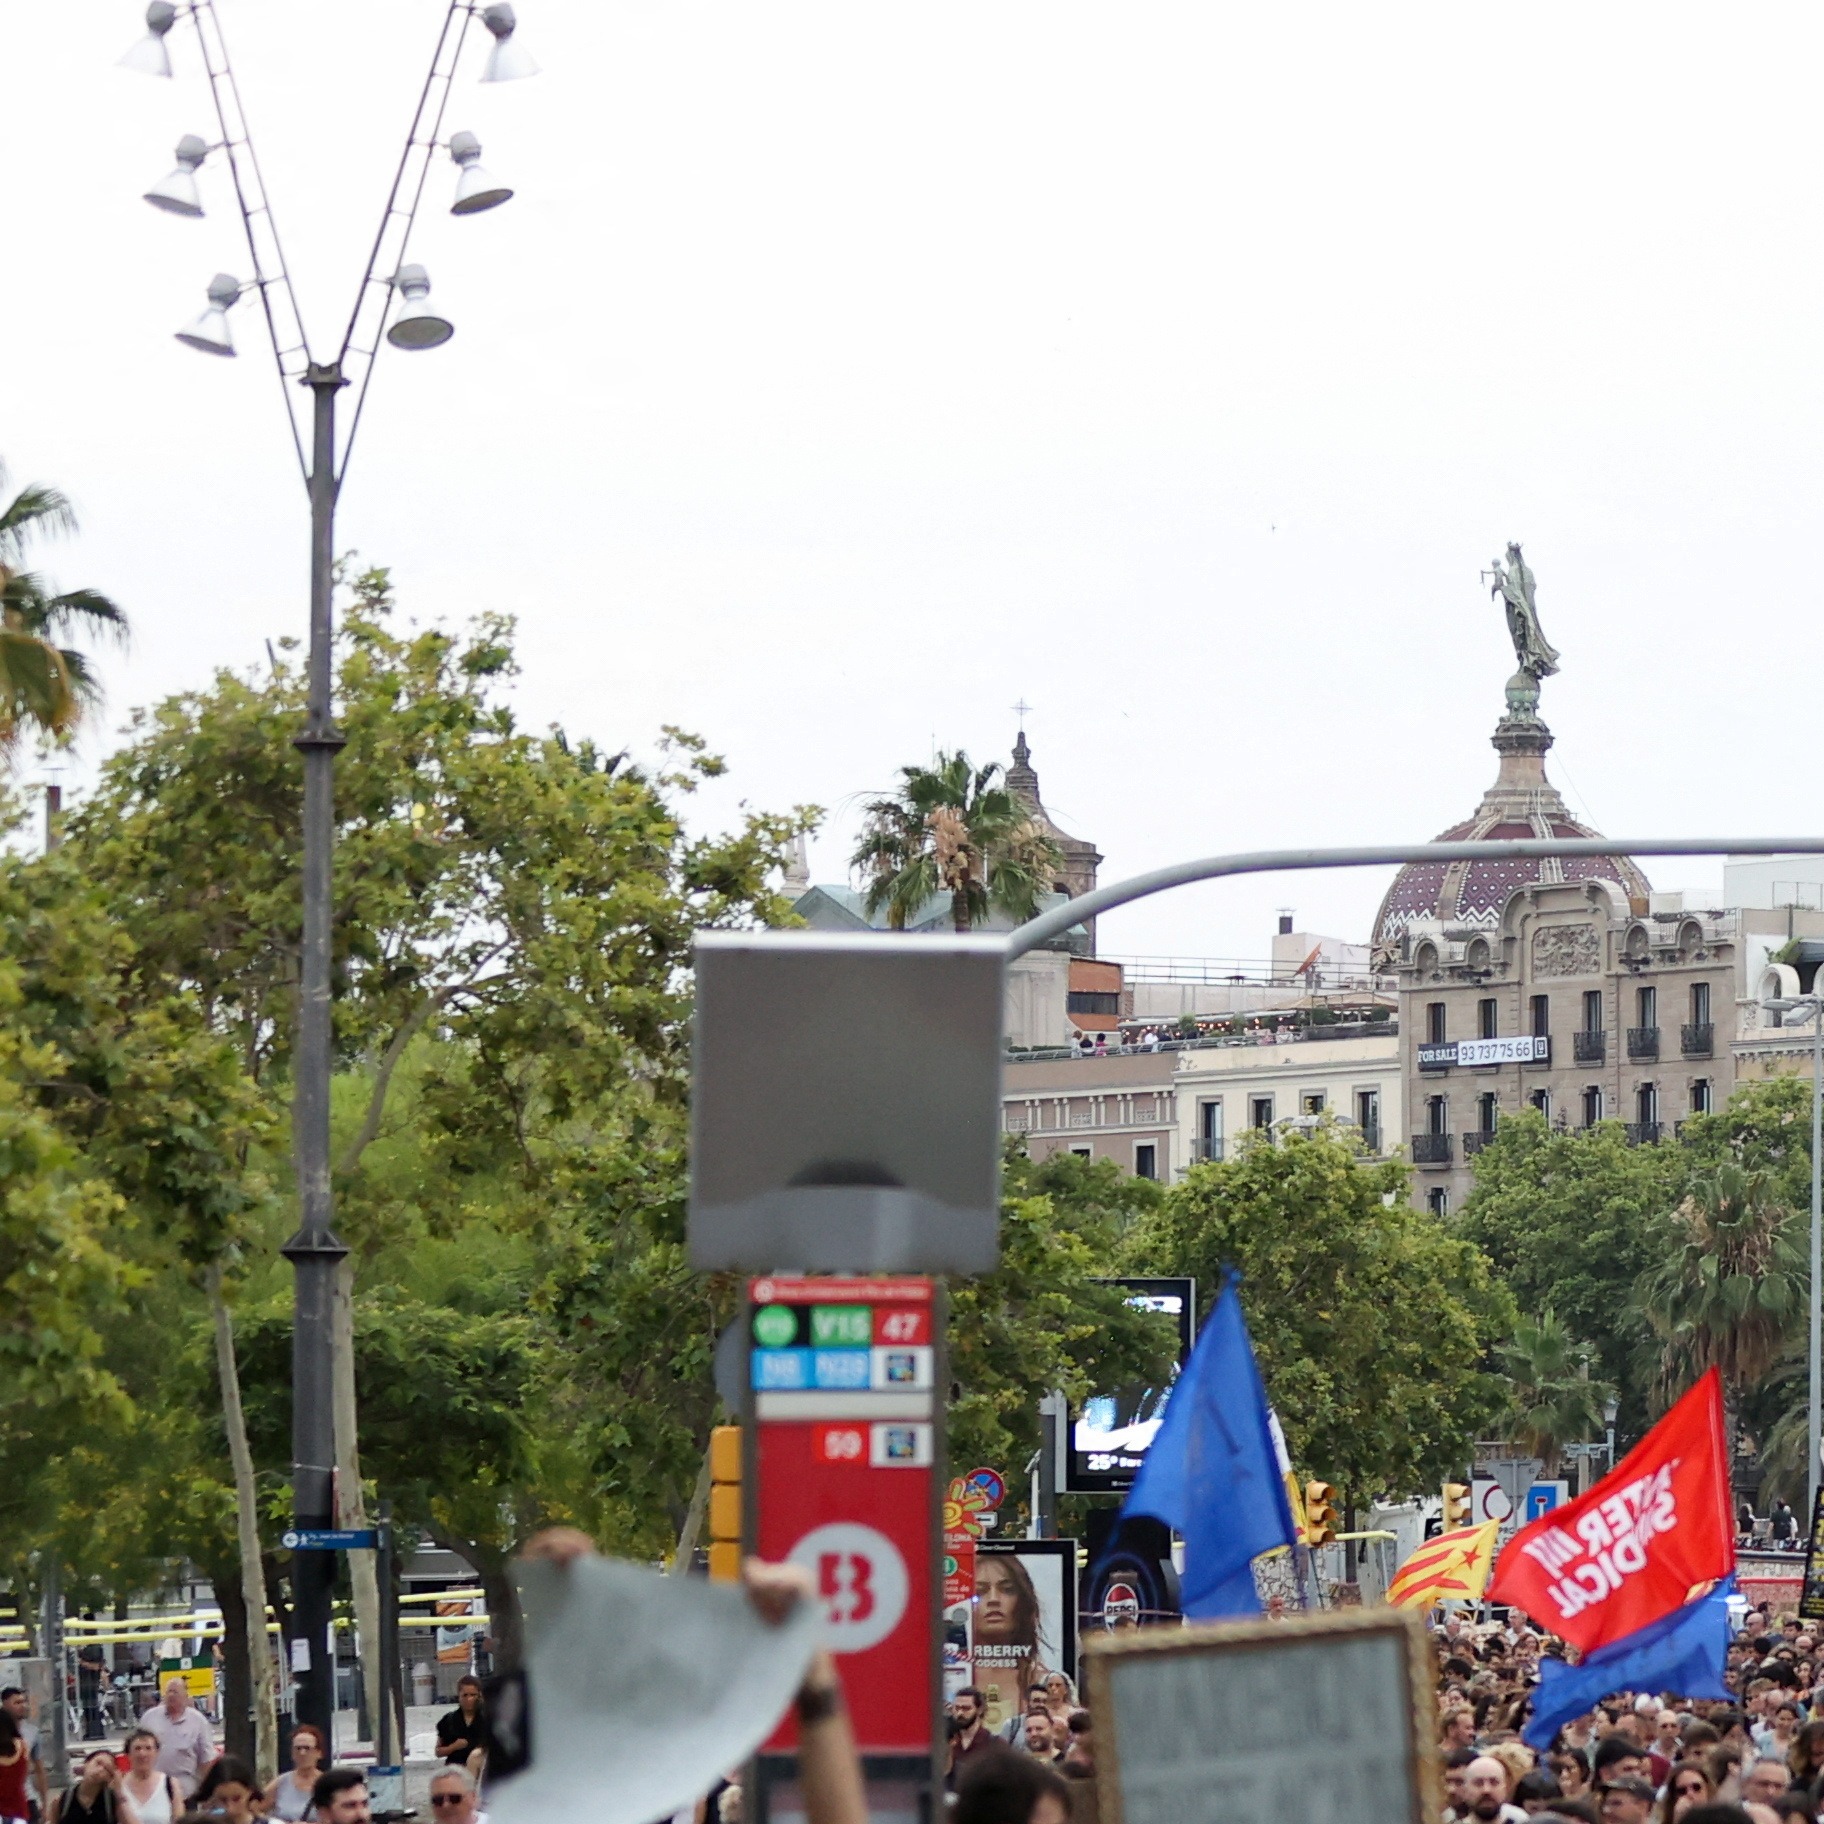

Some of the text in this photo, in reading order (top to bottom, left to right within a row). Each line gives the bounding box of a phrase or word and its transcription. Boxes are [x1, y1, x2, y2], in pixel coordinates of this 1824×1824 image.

[1418, 1050, 1435, 1062] FOR
[1435, 1048, 1457, 1061] SALE
[1461, 1046, 1475, 1060] 93
[1478, 1044, 1498, 1060] 737
[1500, 1043, 1513, 1058] 75
[1516, 1042, 1530, 1057] 66
[882, 1313, 922, 1341] 47
[974, 1645, 1032, 1657] RBERRY
